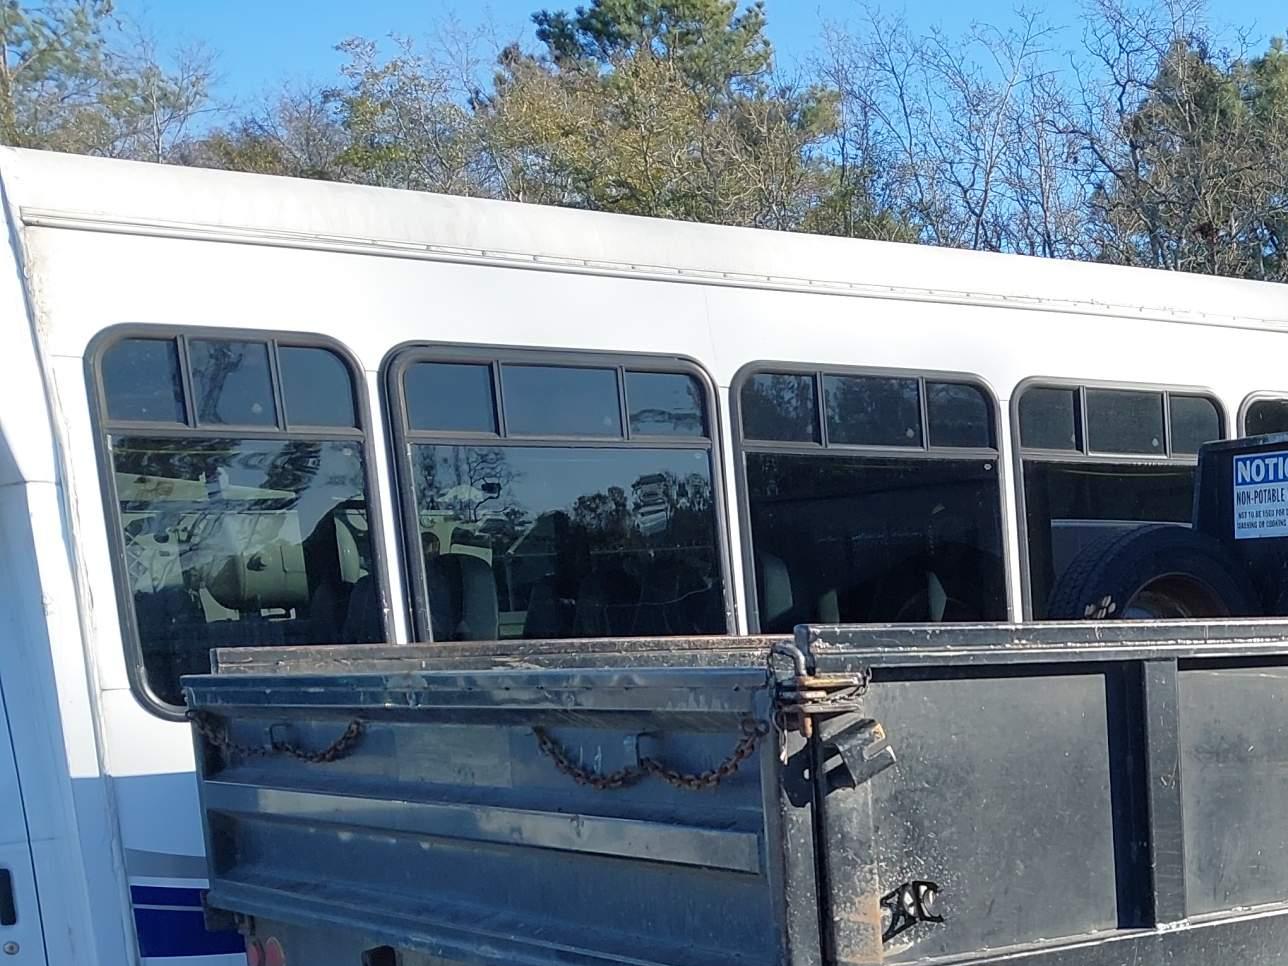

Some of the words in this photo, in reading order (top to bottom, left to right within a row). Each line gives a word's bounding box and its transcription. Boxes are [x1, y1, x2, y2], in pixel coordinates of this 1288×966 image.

[1236, 487, 1285, 506] NON-POTABLE
[1248, 510, 1254, 518] TO
[1275, 508, 1285, 517] FOR
[1265, 518, 1287, 528] COOKING
